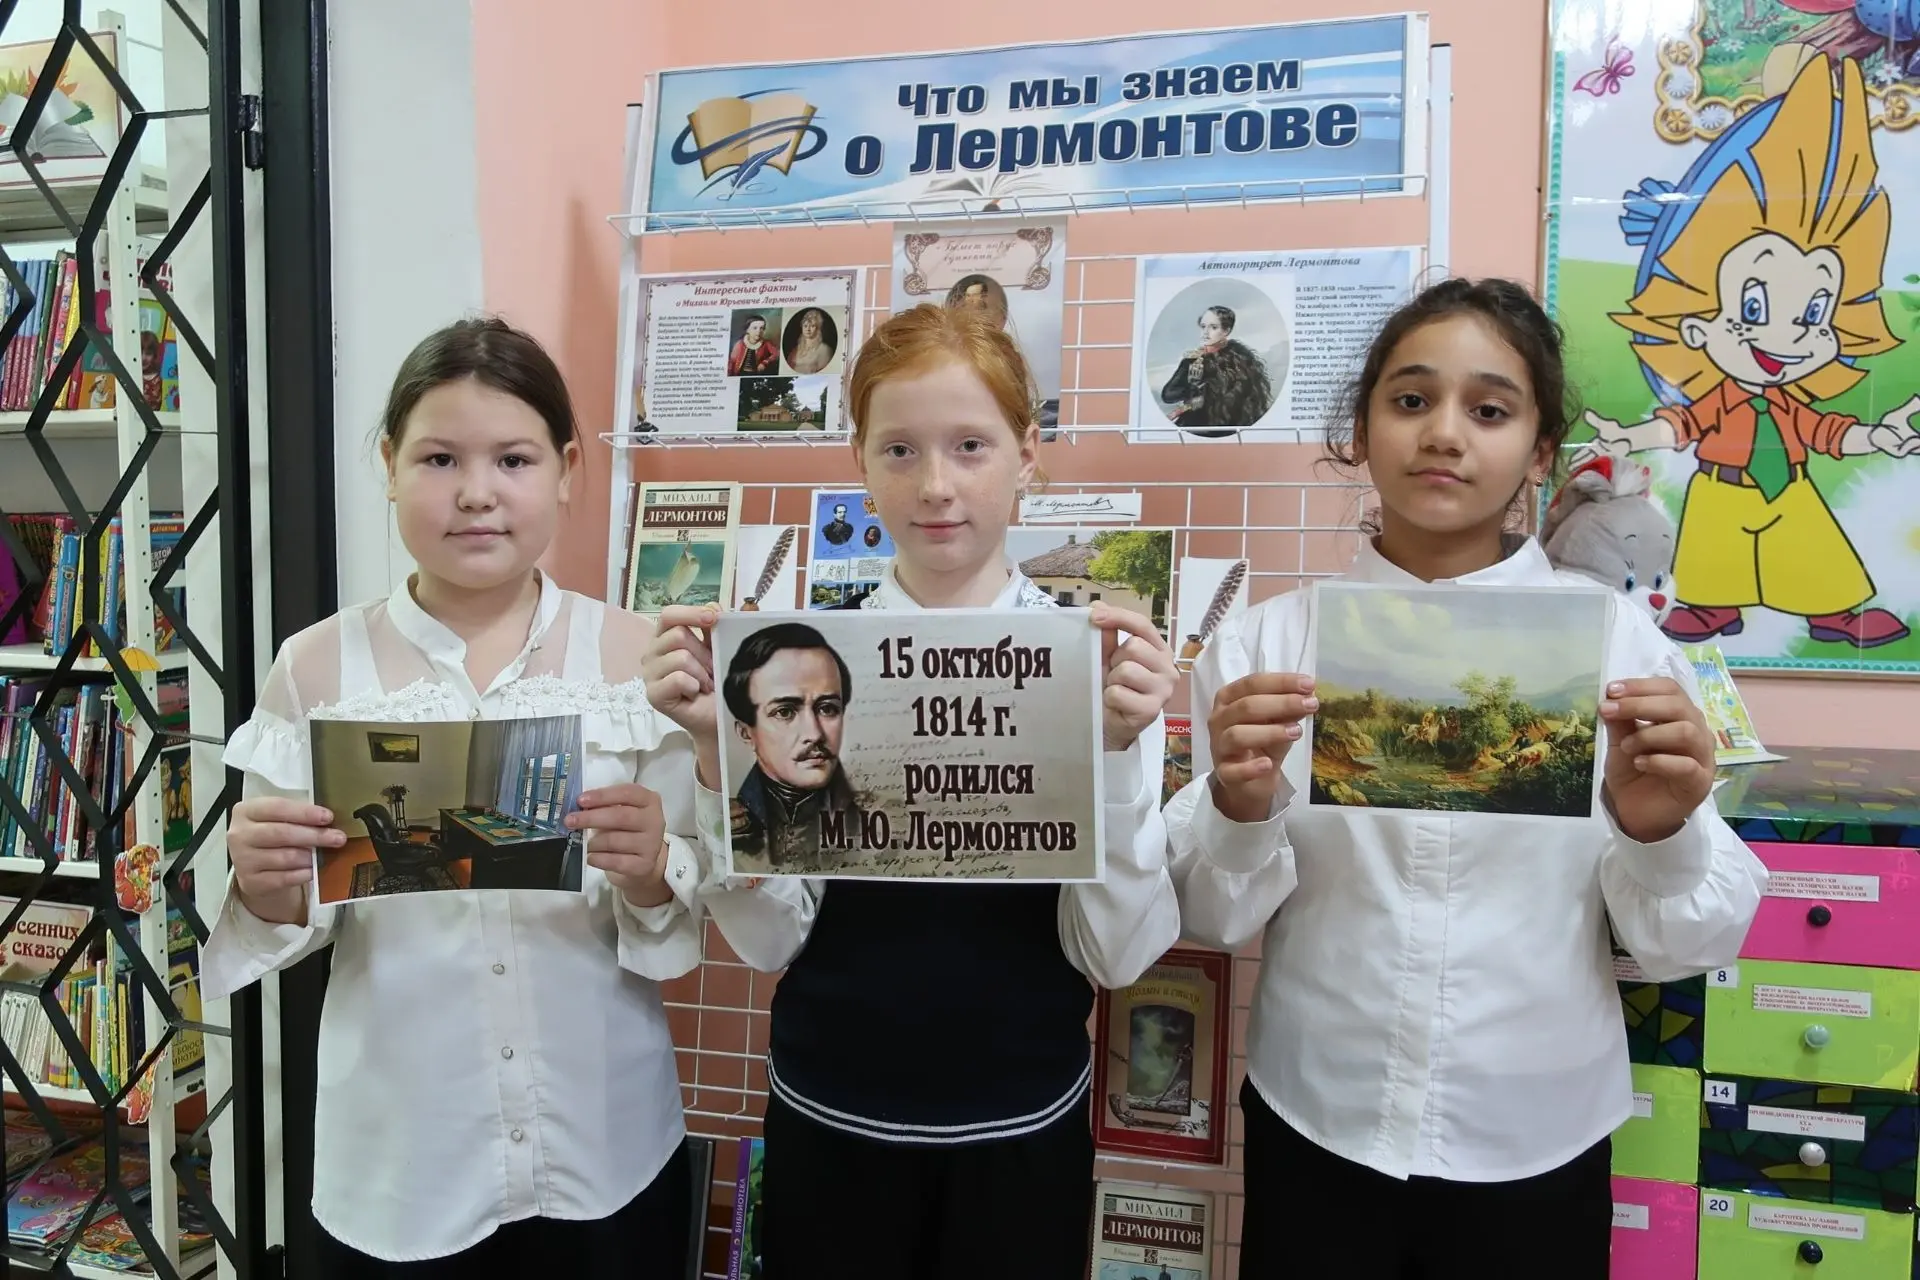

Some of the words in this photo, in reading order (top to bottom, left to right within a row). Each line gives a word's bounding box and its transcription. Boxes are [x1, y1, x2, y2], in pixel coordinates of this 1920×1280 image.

[897, 81, 987, 117] Что
[1008, 75, 1099, 112] мы
[1121, 58, 1301, 102] знаем
[842, 132, 884, 178] о
[909, 102, 1361, 175] Лермонтове
[1198, 260, 1283, 272] Автопортрет
[1284, 257, 1361, 269] Лермонтова
[694, 286, 757, 297] Интересные
[758, 283, 797, 295] факты
[720, 296, 761, 308] Юрьевиче
[761, 295, 817, 306] Лермонтове
[662, 493, 712, 503] МИХАИЛ
[644, 510, 727, 523] ЛЕРМОНТОВ
[877, 636, 914, 679] 15
[922, 635, 1052, 689] октября
[911, 696, 987, 736] 1814
[993, 706, 1017, 736] г.
[904, 763, 1034, 805] родился
[819, 811, 854, 849] М.
[861, 810, 898, 850] Ю.
[904, 811, 1077, 861] Лермонтов
[1717, 970, 1726, 982] 8
[1711, 1085, 1729, 1097] 14
[734, 1179, 746, 1233] БИБЛИОТЕКА
[1125, 1202, 1183, 1219] МИХАИЛ
[1709, 1200, 1729, 1212] 20
[1104, 1221, 1202, 1245] ЛЕРМОНТОВ
